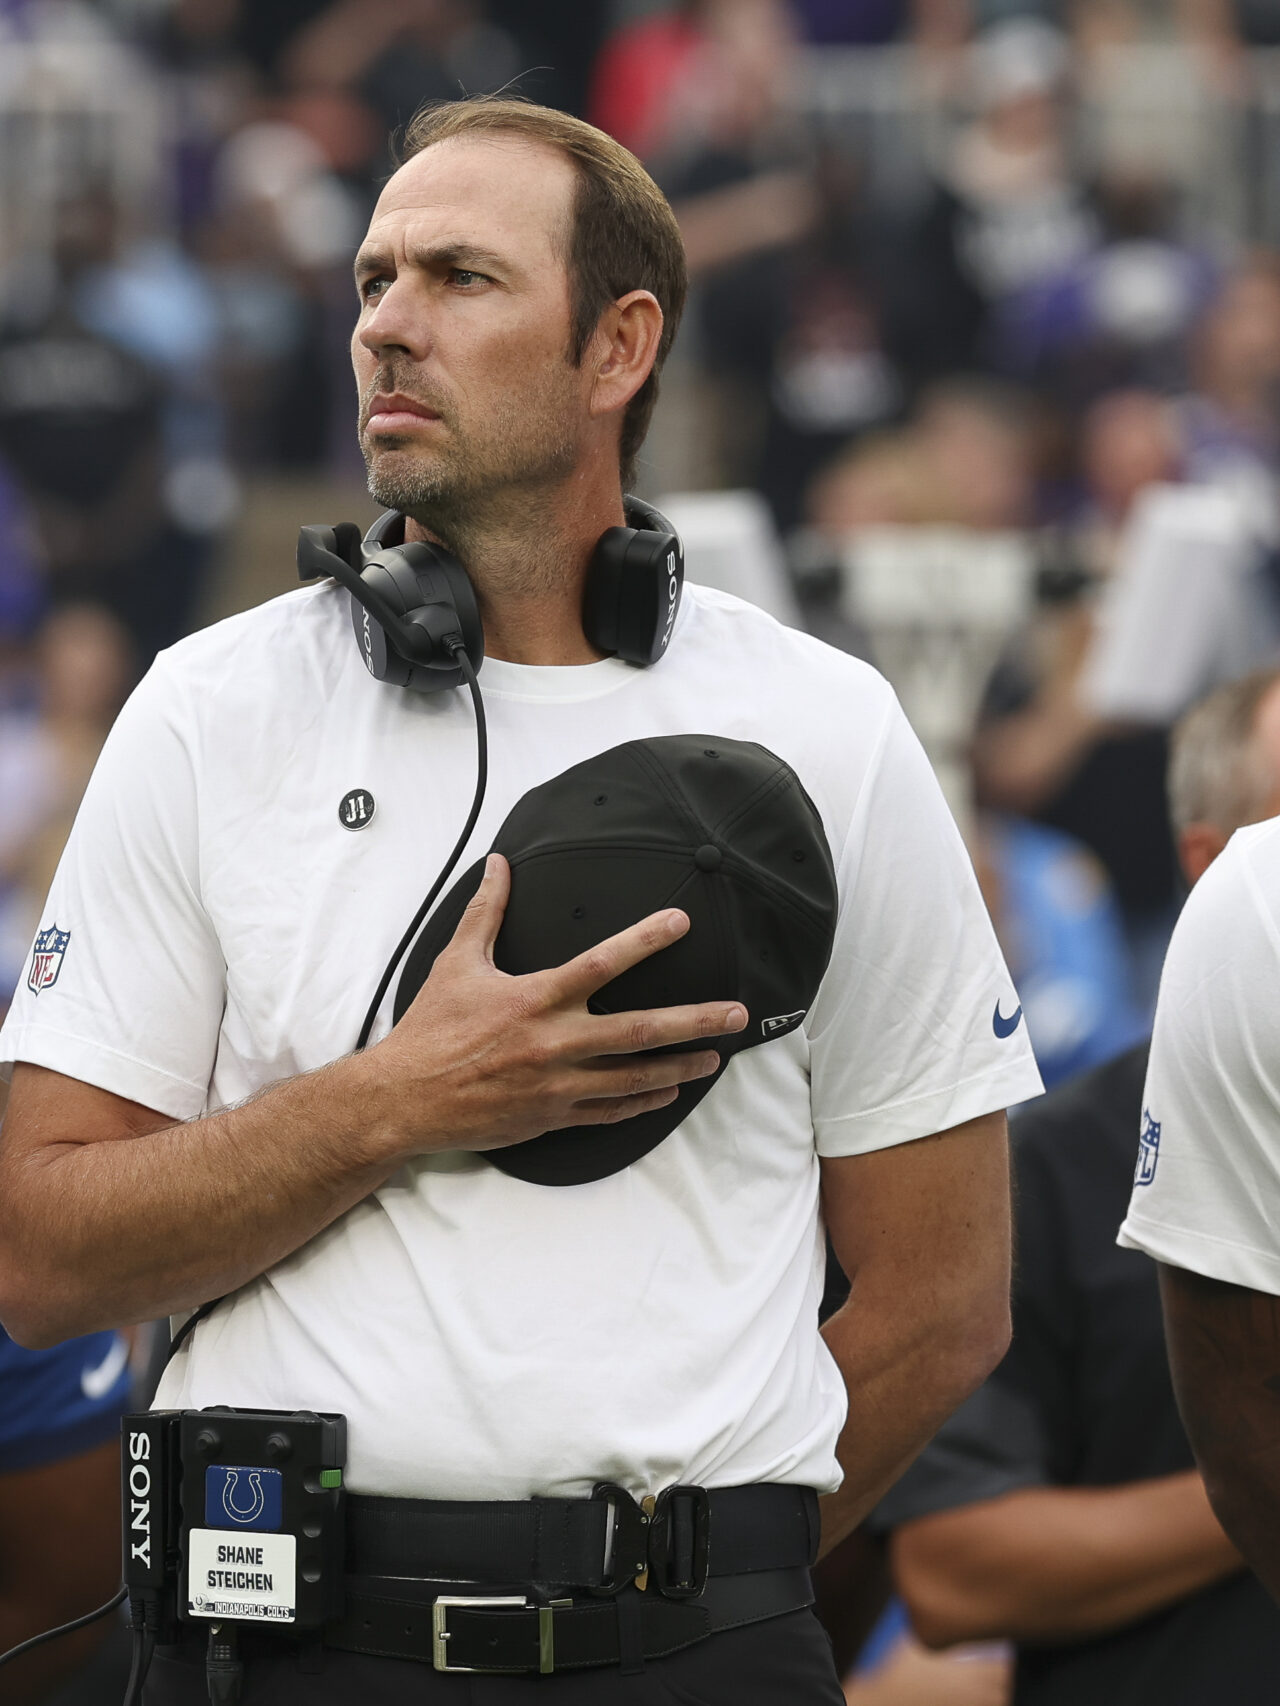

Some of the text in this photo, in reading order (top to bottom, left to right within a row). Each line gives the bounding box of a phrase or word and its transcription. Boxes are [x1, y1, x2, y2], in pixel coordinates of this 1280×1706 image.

[662, 551, 677, 646] SONY
[129, 1432, 152, 1570] SONY
[218, 1545, 263, 1564] SHANE
[208, 1570, 273, 1591] STEICHEN
[214, 1601, 290, 1619] INDIANAPOLIS COLTS
